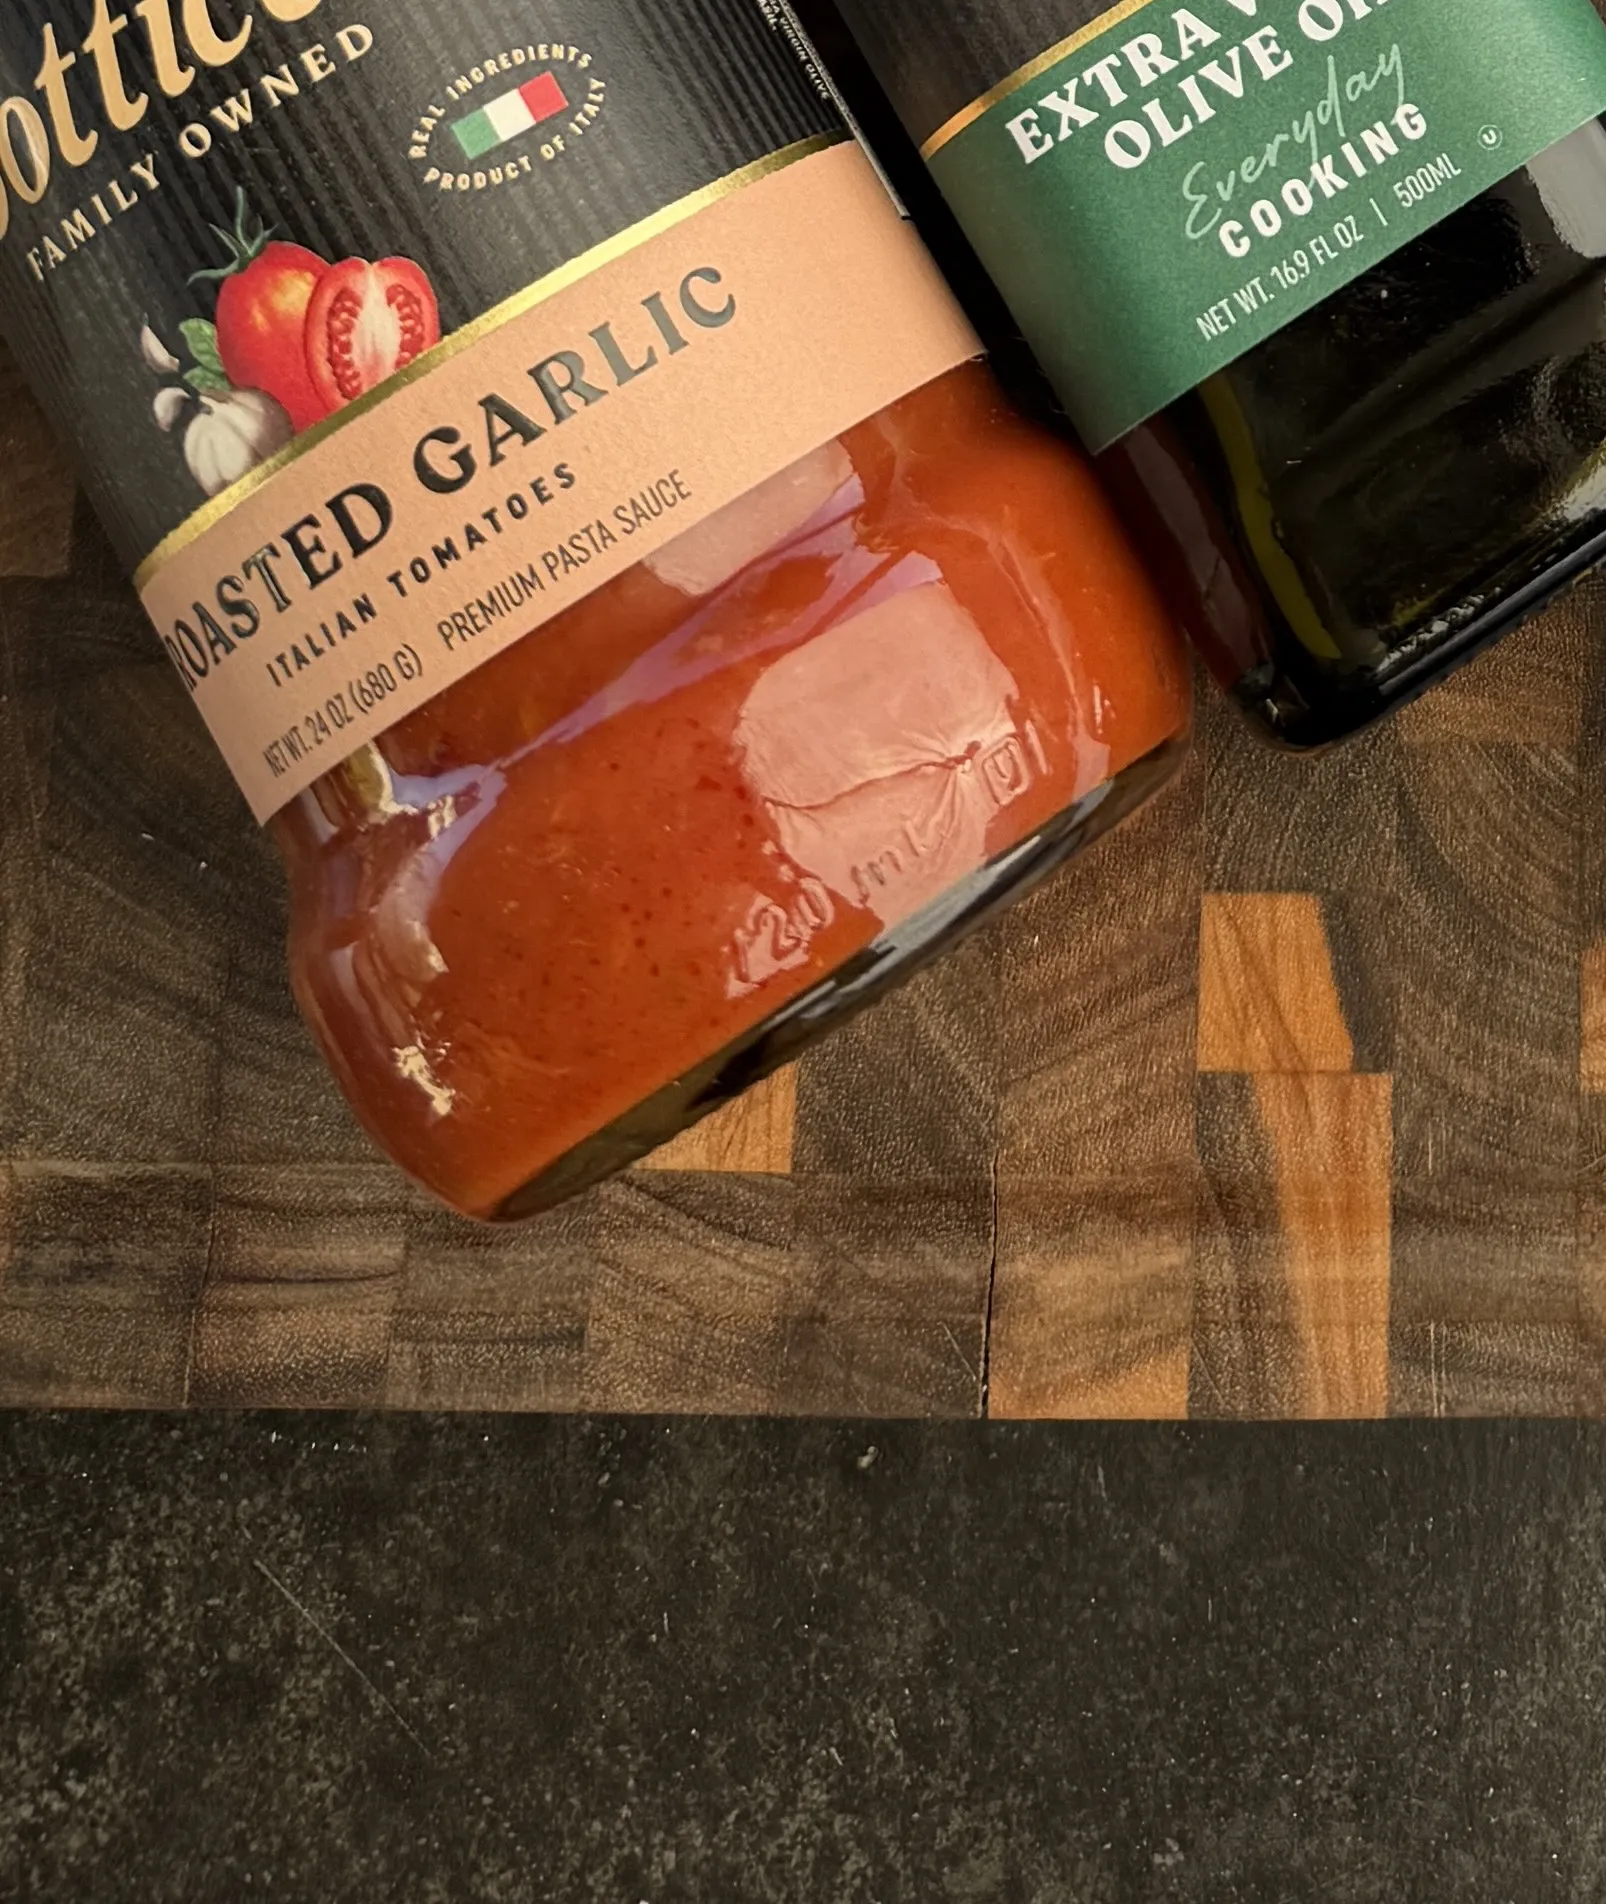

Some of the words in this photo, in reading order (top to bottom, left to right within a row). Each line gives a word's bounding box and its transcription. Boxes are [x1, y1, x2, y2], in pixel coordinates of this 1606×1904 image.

[408, 103, 447, 160] REAL
[445, 43, 594, 101] INGREDIENTS
[780, 15, 808, 62] VIRGIN
[1004, 7, 1222, 165] EXTRA
[1102, 24, 1294, 170] OLIVE
[25, 152, 162, 283] FAMILY
[178, 22, 375, 160] OWNED
[422, 154, 533, 192] PRODUCT
[540, 133, 566, 162] OF
[567, 77, 607, 137] ITALY
[1182, 43, 1405, 241] Everyday
[1218, 102, 1428, 258] COOKING
[1195, 298, 1237, 342] NET
[1232, 276, 1276, 317] WT.
[1270, 249, 1311, 290] 16.9
[1309, 234, 1340, 266] FL
[1333, 214, 1364, 249] OZ
[1392, 152, 1462, 208] 500ML
[412, 266, 738, 496] GARLIC
[266, 594, 379, 688] ITALIAN
[387, 461, 578, 597] TOMATOES
[436, 562, 546, 652] PREMIUM
[541, 519, 618, 582] PASTA
[612, 468, 692, 535] SAUCE
[262, 739, 291, 779] NET
[281, 725, 313, 762] WT.
[304, 710, 333, 746] 24
[325, 693, 354, 730] OZ
[348, 662, 398, 715] (680
[393, 642, 423, 681] G)
